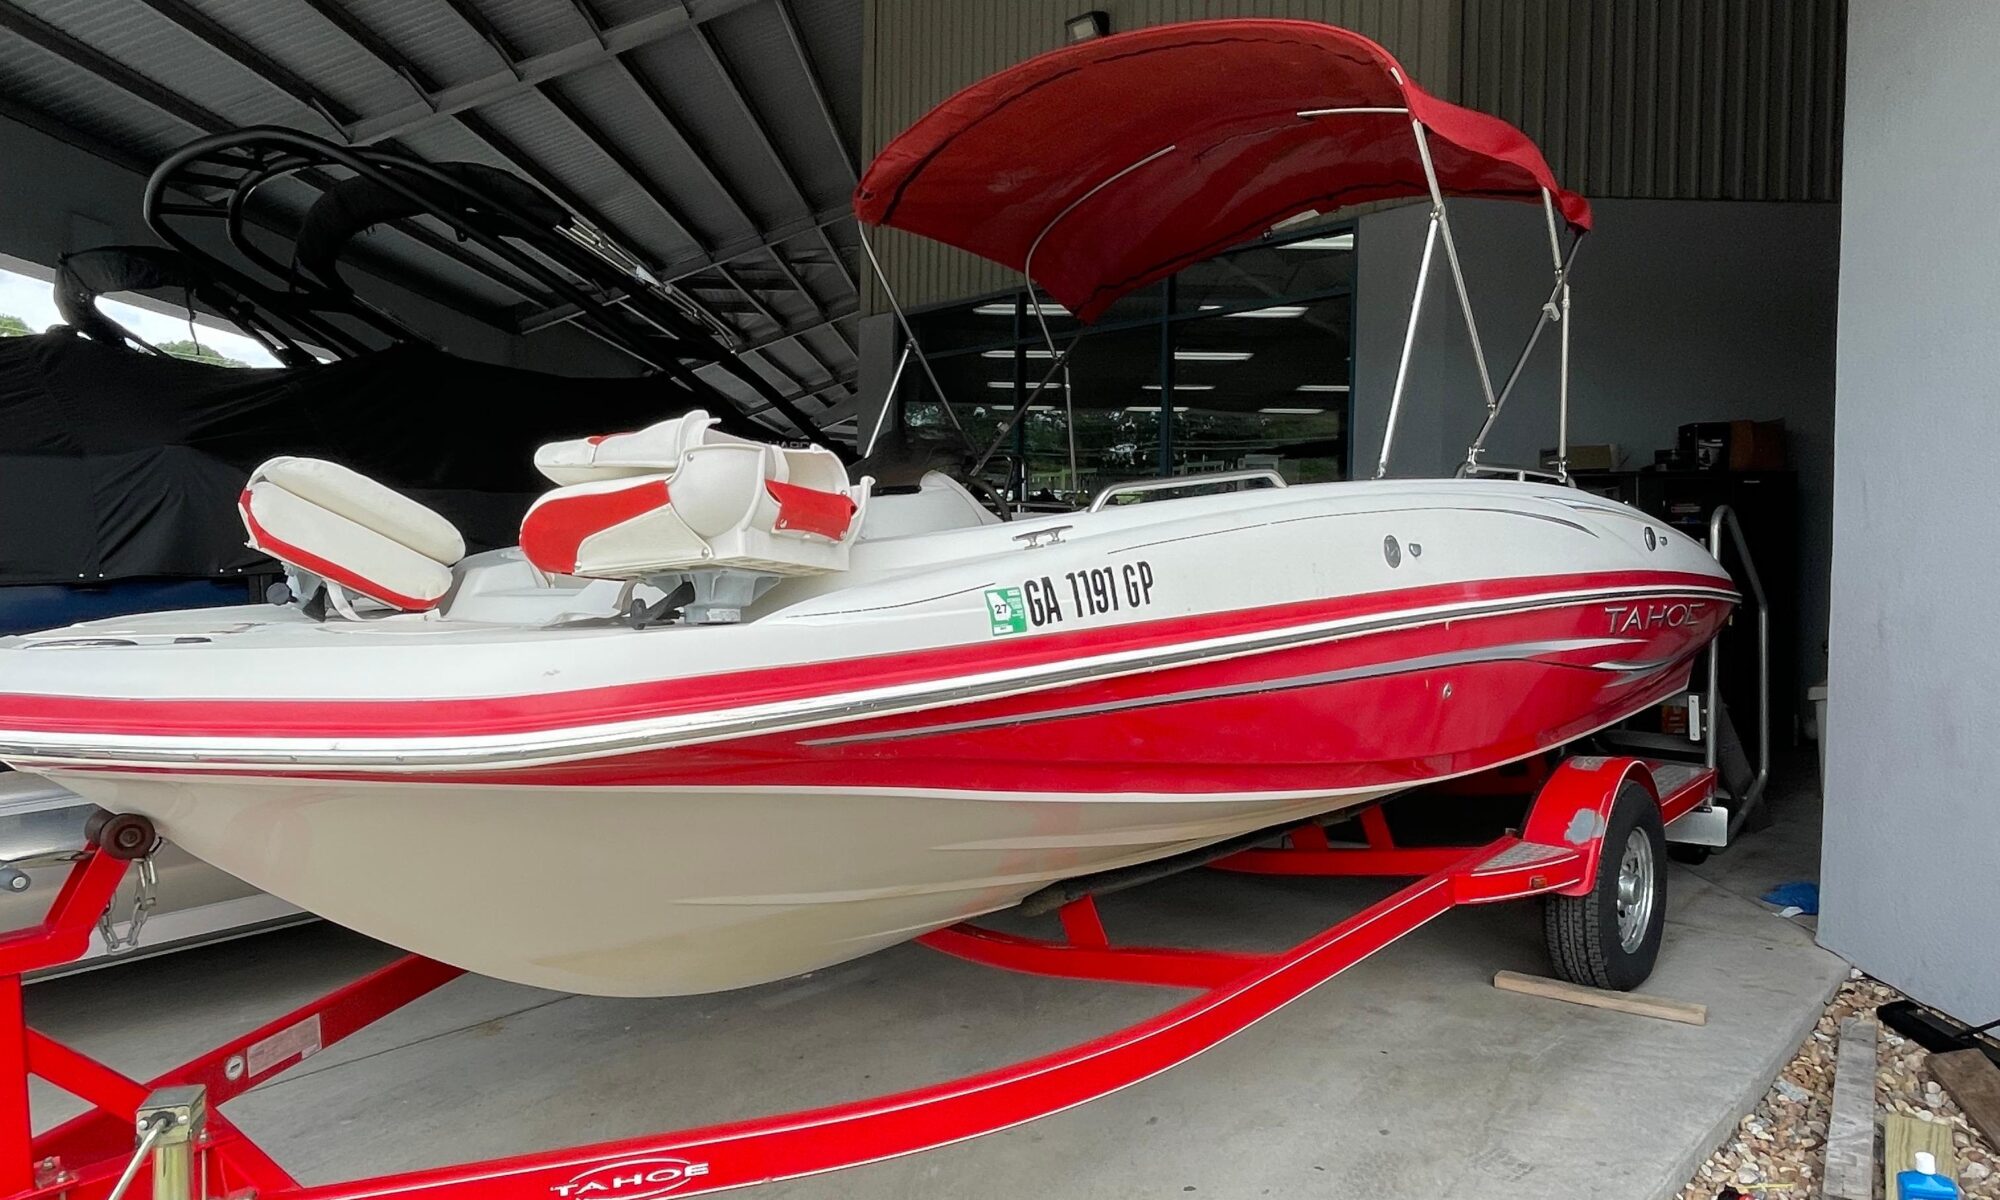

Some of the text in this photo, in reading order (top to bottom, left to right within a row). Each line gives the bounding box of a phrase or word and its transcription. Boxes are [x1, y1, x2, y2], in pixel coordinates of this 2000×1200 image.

[994, 604, 1007, 614] 27
[1024, 576, 1063, 627] GA
[1065, 566, 1119, 618] 1191
[1122, 561, 1153, 608] GP
[1604, 603, 1705, 633] TAHOE
[550, 1163, 709, 1197] TAHOE
